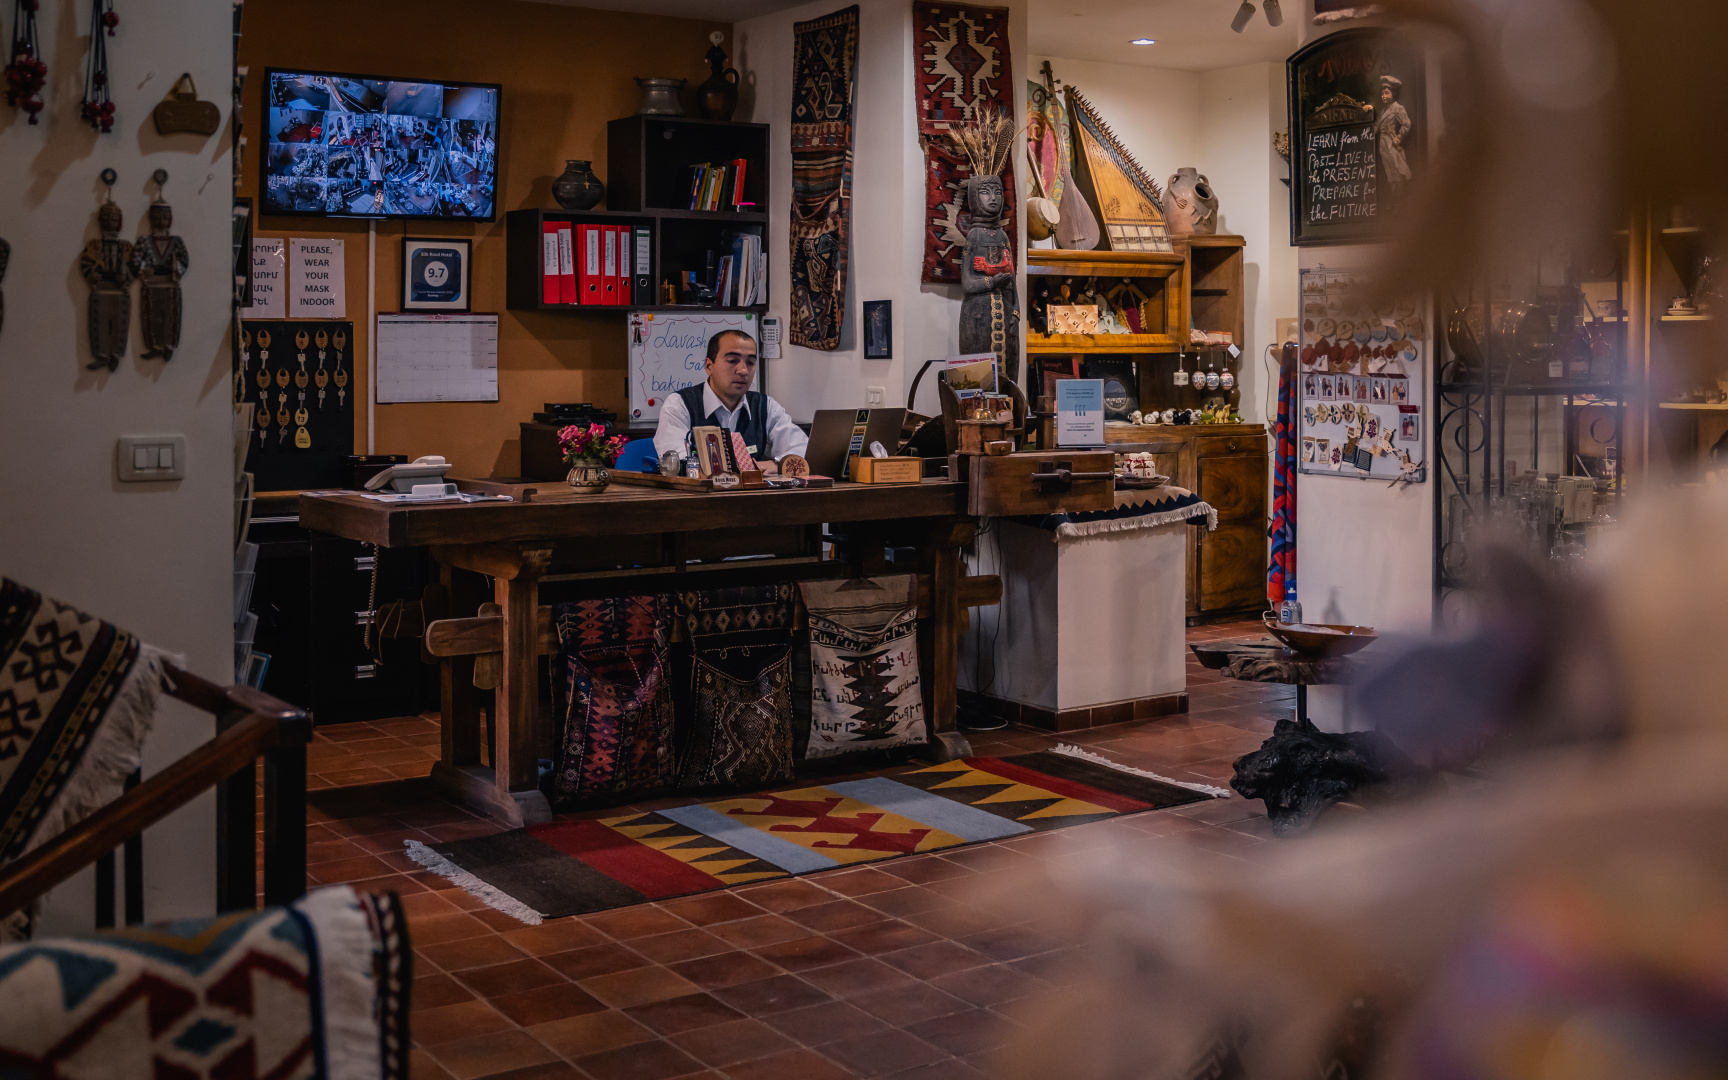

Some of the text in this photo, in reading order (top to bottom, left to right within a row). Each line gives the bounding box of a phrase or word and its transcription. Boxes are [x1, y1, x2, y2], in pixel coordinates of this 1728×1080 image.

[1308, 127, 1375, 151] LEARN from the
[1336, 152, 1361, 167] LIVE
[1363, 152, 1375, 164] in
[1308, 170, 1321, 184] the
[1312, 181, 1376, 202] PREPARE for
[1310, 203, 1376, 221] the FUTURE
[301, 245, 333, 255] PLEASE,
[305, 272, 329, 280] YOUR
[428, 268, 445, 278] 9.7
[304, 285, 330, 293] MASK
[300, 298, 335, 306] INDOOR
[654, 321, 707, 349] Lavash
